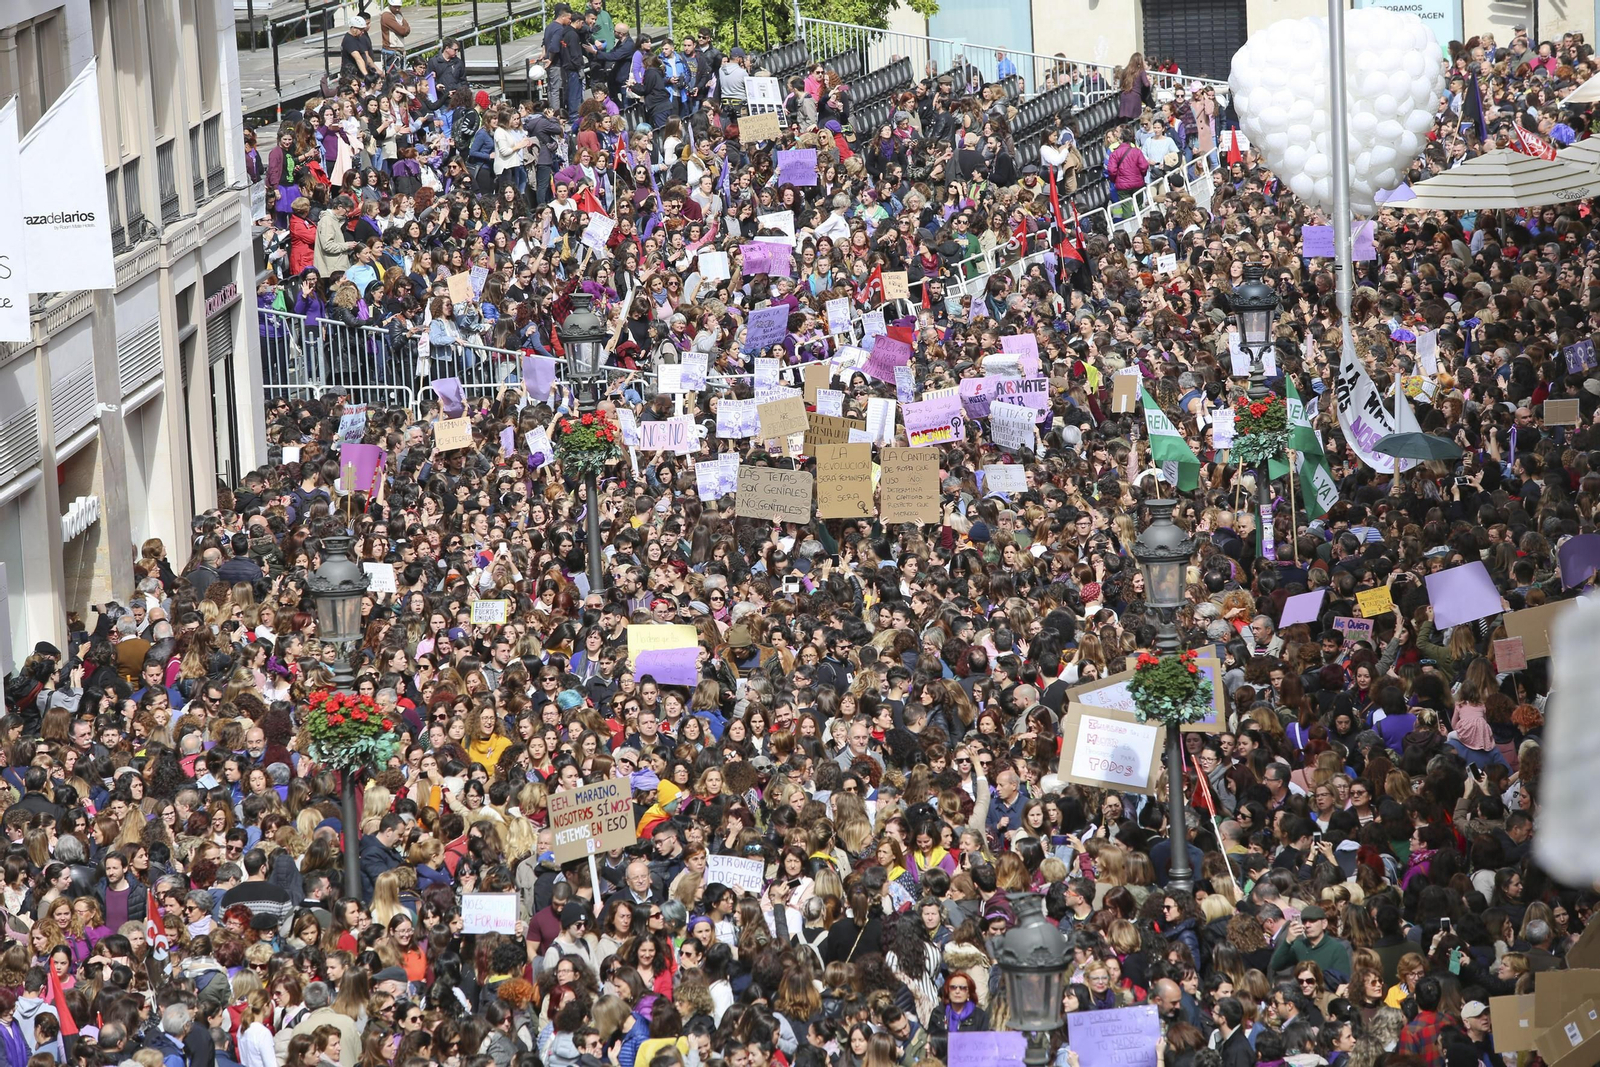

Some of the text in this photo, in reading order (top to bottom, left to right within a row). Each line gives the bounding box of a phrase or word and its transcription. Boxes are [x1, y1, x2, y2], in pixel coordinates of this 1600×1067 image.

[668, 422, 683, 446] NO
[911, 425, 952, 446] QUEMAR
[831, 446, 848, 460] LA
[882, 450, 938, 462] LA CANTIDAD
[739, 468, 797, 484] LAS TETAS
[839, 474, 871, 482] FEMINISTA
[884, 466, 894, 474] DE
[741, 483, 808, 498] SON GENIALES
[741, 498, 802, 515] NO GENITALES
[819, 496, 828, 505] NO
[1089, 757, 1134, 777] TODOS
[554, 797, 632, 828] NOSOTRXS SÍ NOS
[555, 825, 590, 846] METEMOS
[591, 821, 602, 836] EN
[712, 856, 762, 874] STRONGER
[710, 871, 761, 888] TOGETHER
